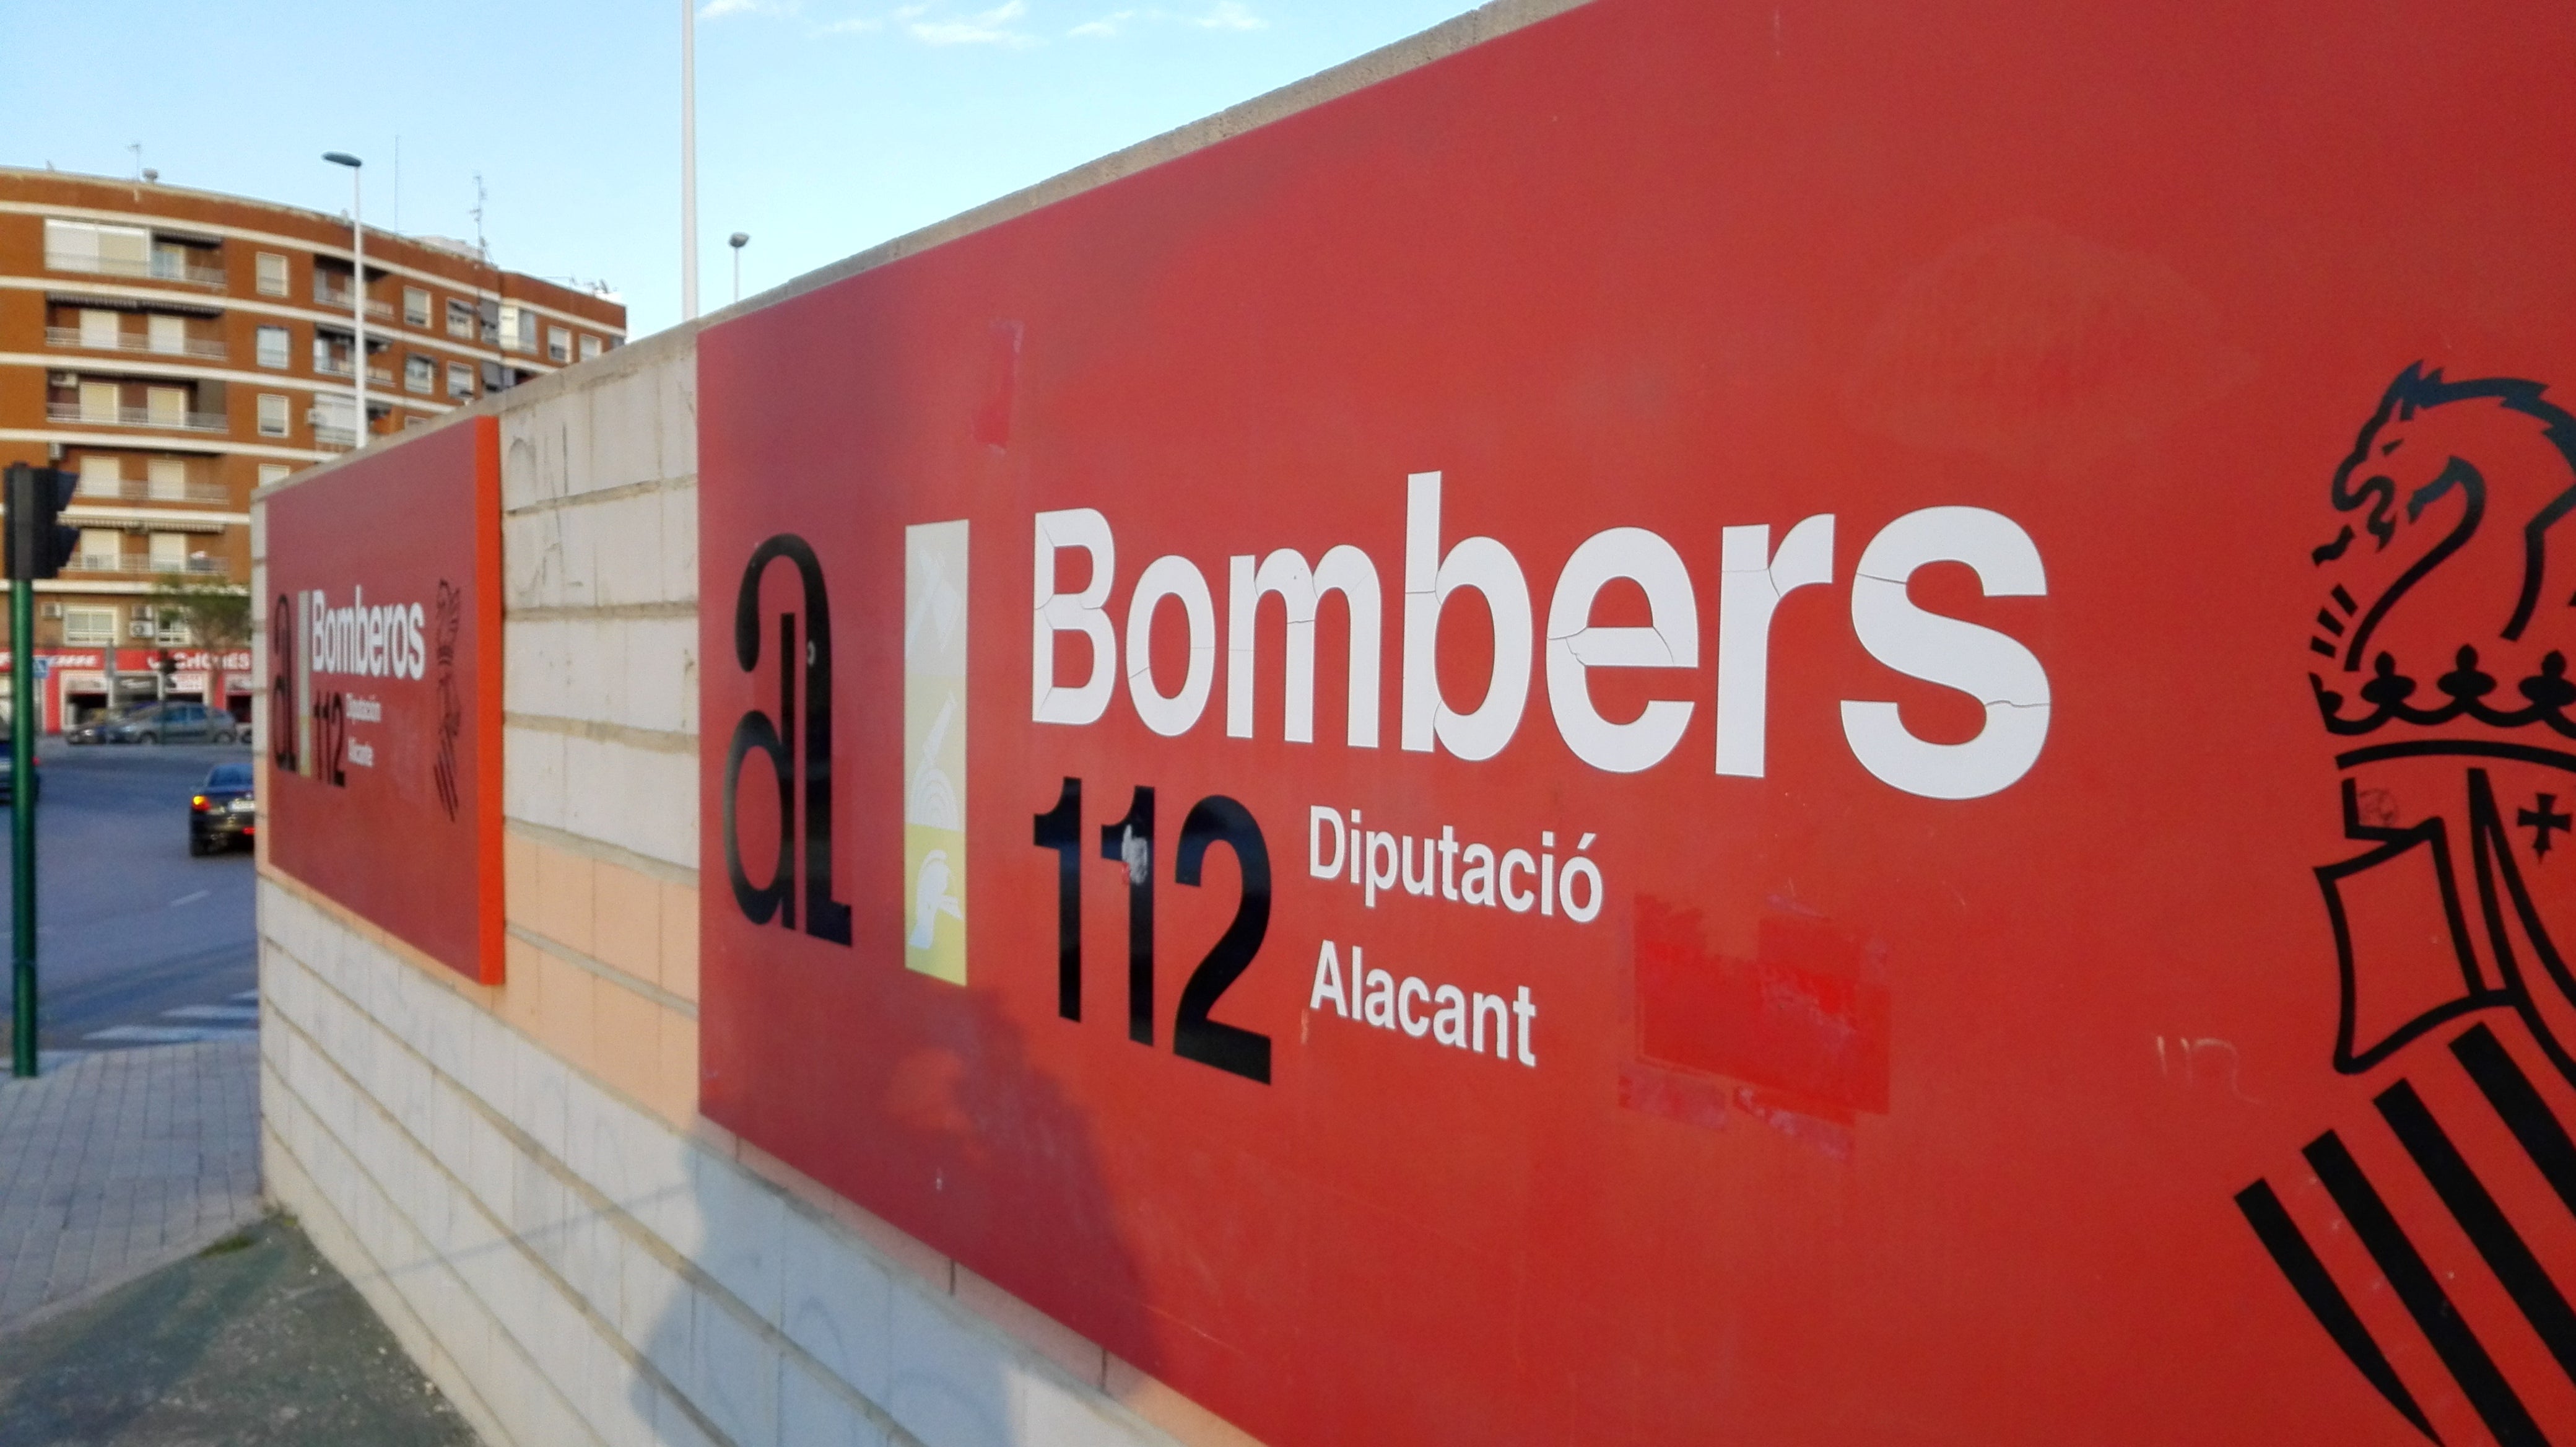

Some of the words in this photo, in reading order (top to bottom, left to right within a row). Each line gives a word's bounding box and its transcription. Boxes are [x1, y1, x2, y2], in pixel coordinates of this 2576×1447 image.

[312, 584, 426, 681] Bomberos
[1032, 471, 2052, 800] Bombers
[314, 689, 346, 787] 112
[1309, 805, 1604, 923] Diputació
[1033, 776, 1272, 1085] 112
[1310, 940, 1536, 1067] Alacant
